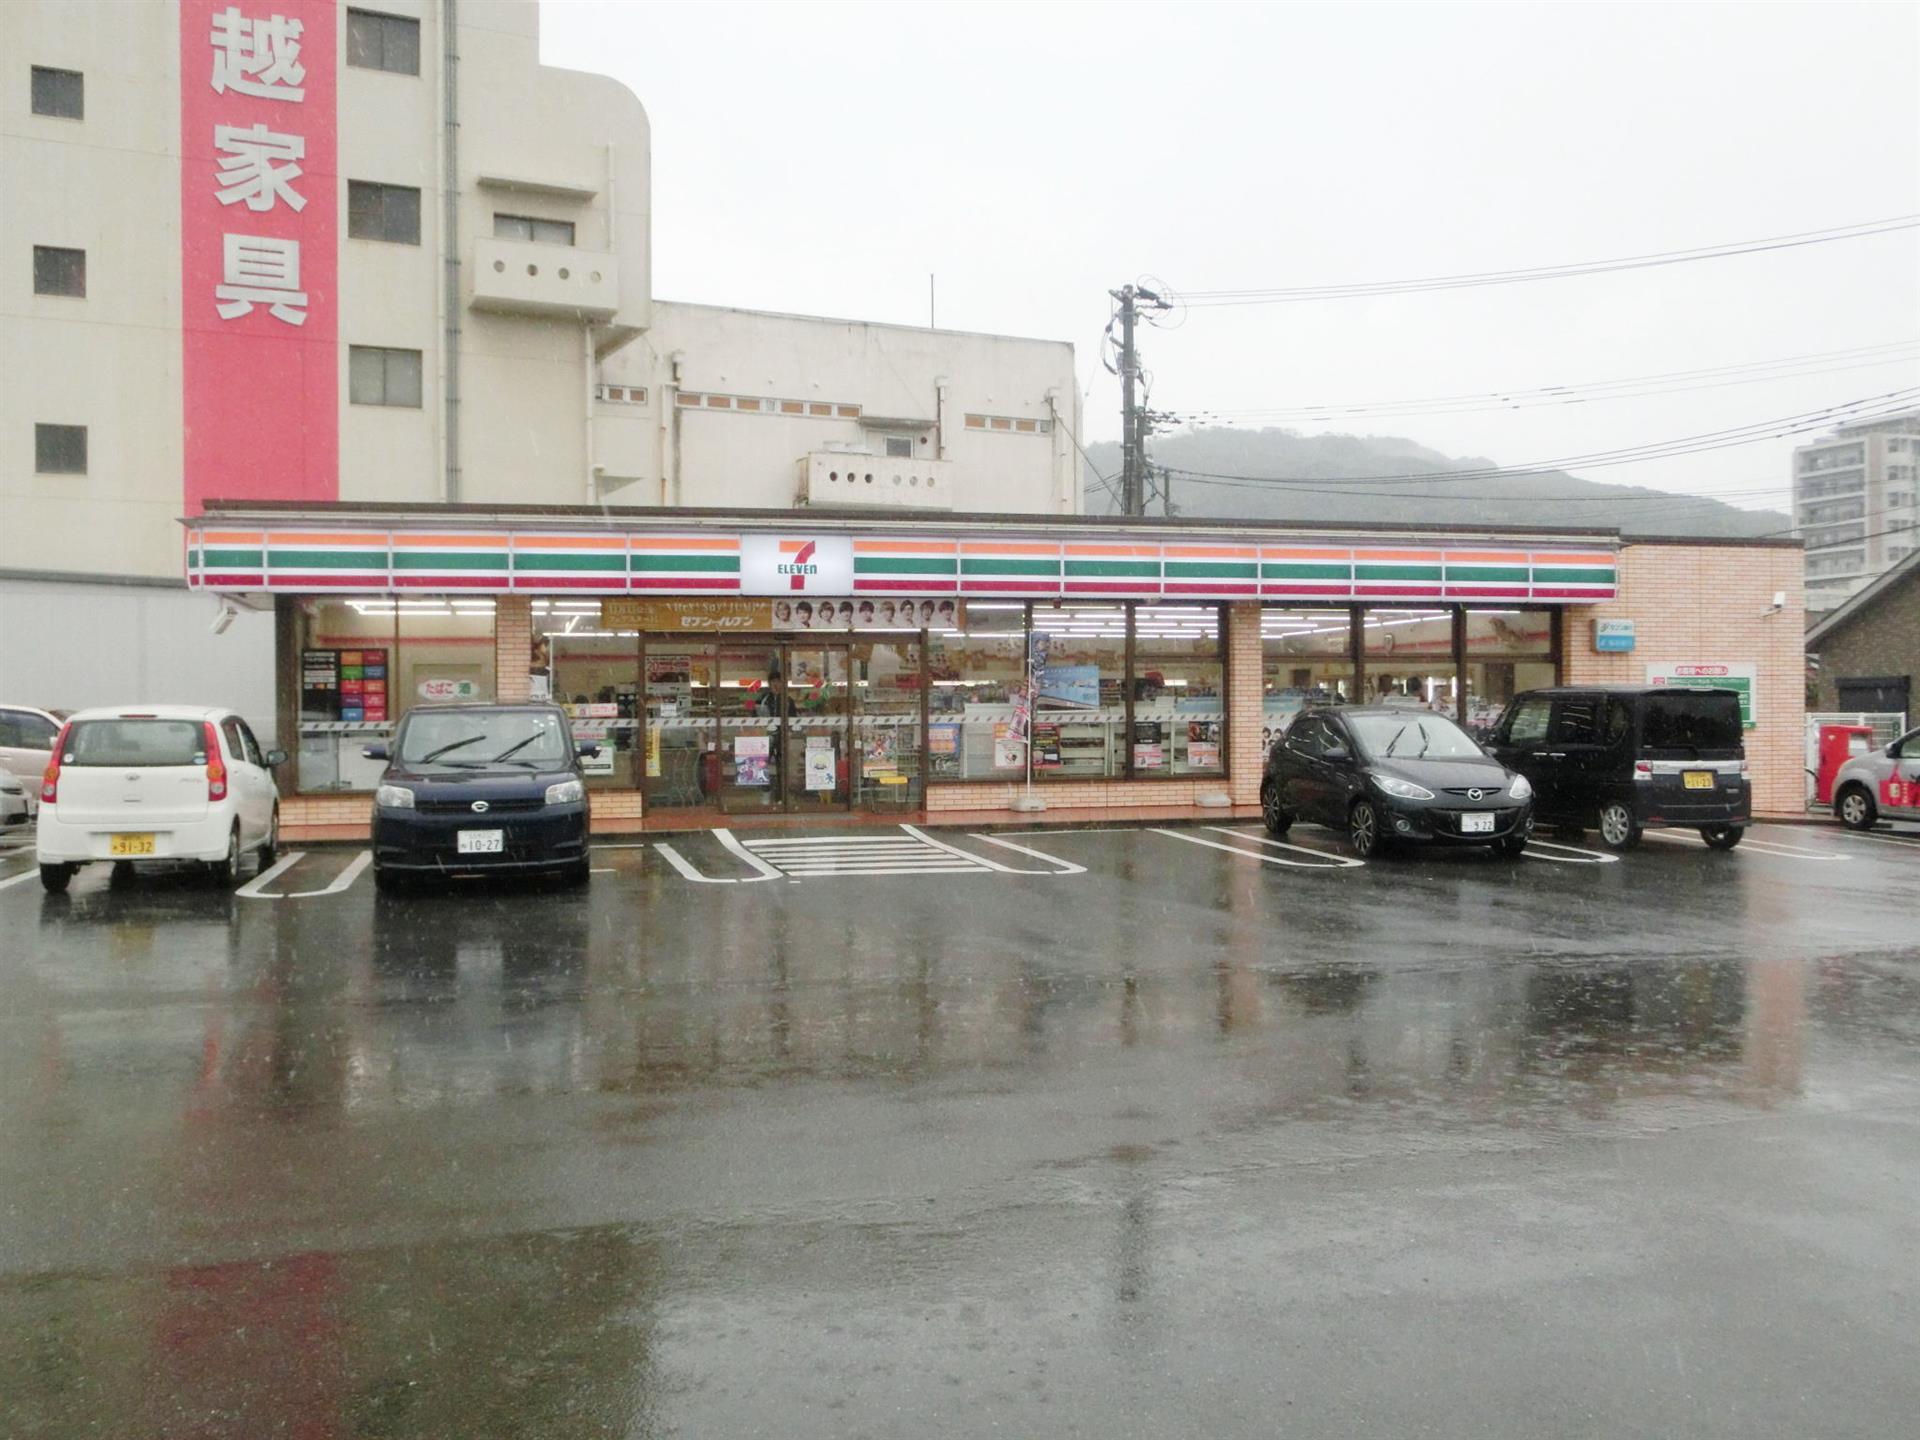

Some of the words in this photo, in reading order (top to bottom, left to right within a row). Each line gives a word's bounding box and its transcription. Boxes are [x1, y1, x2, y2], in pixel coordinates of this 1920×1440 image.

[209, 6, 308, 326] 越家具
[470, 840, 500, 850] 10-27
